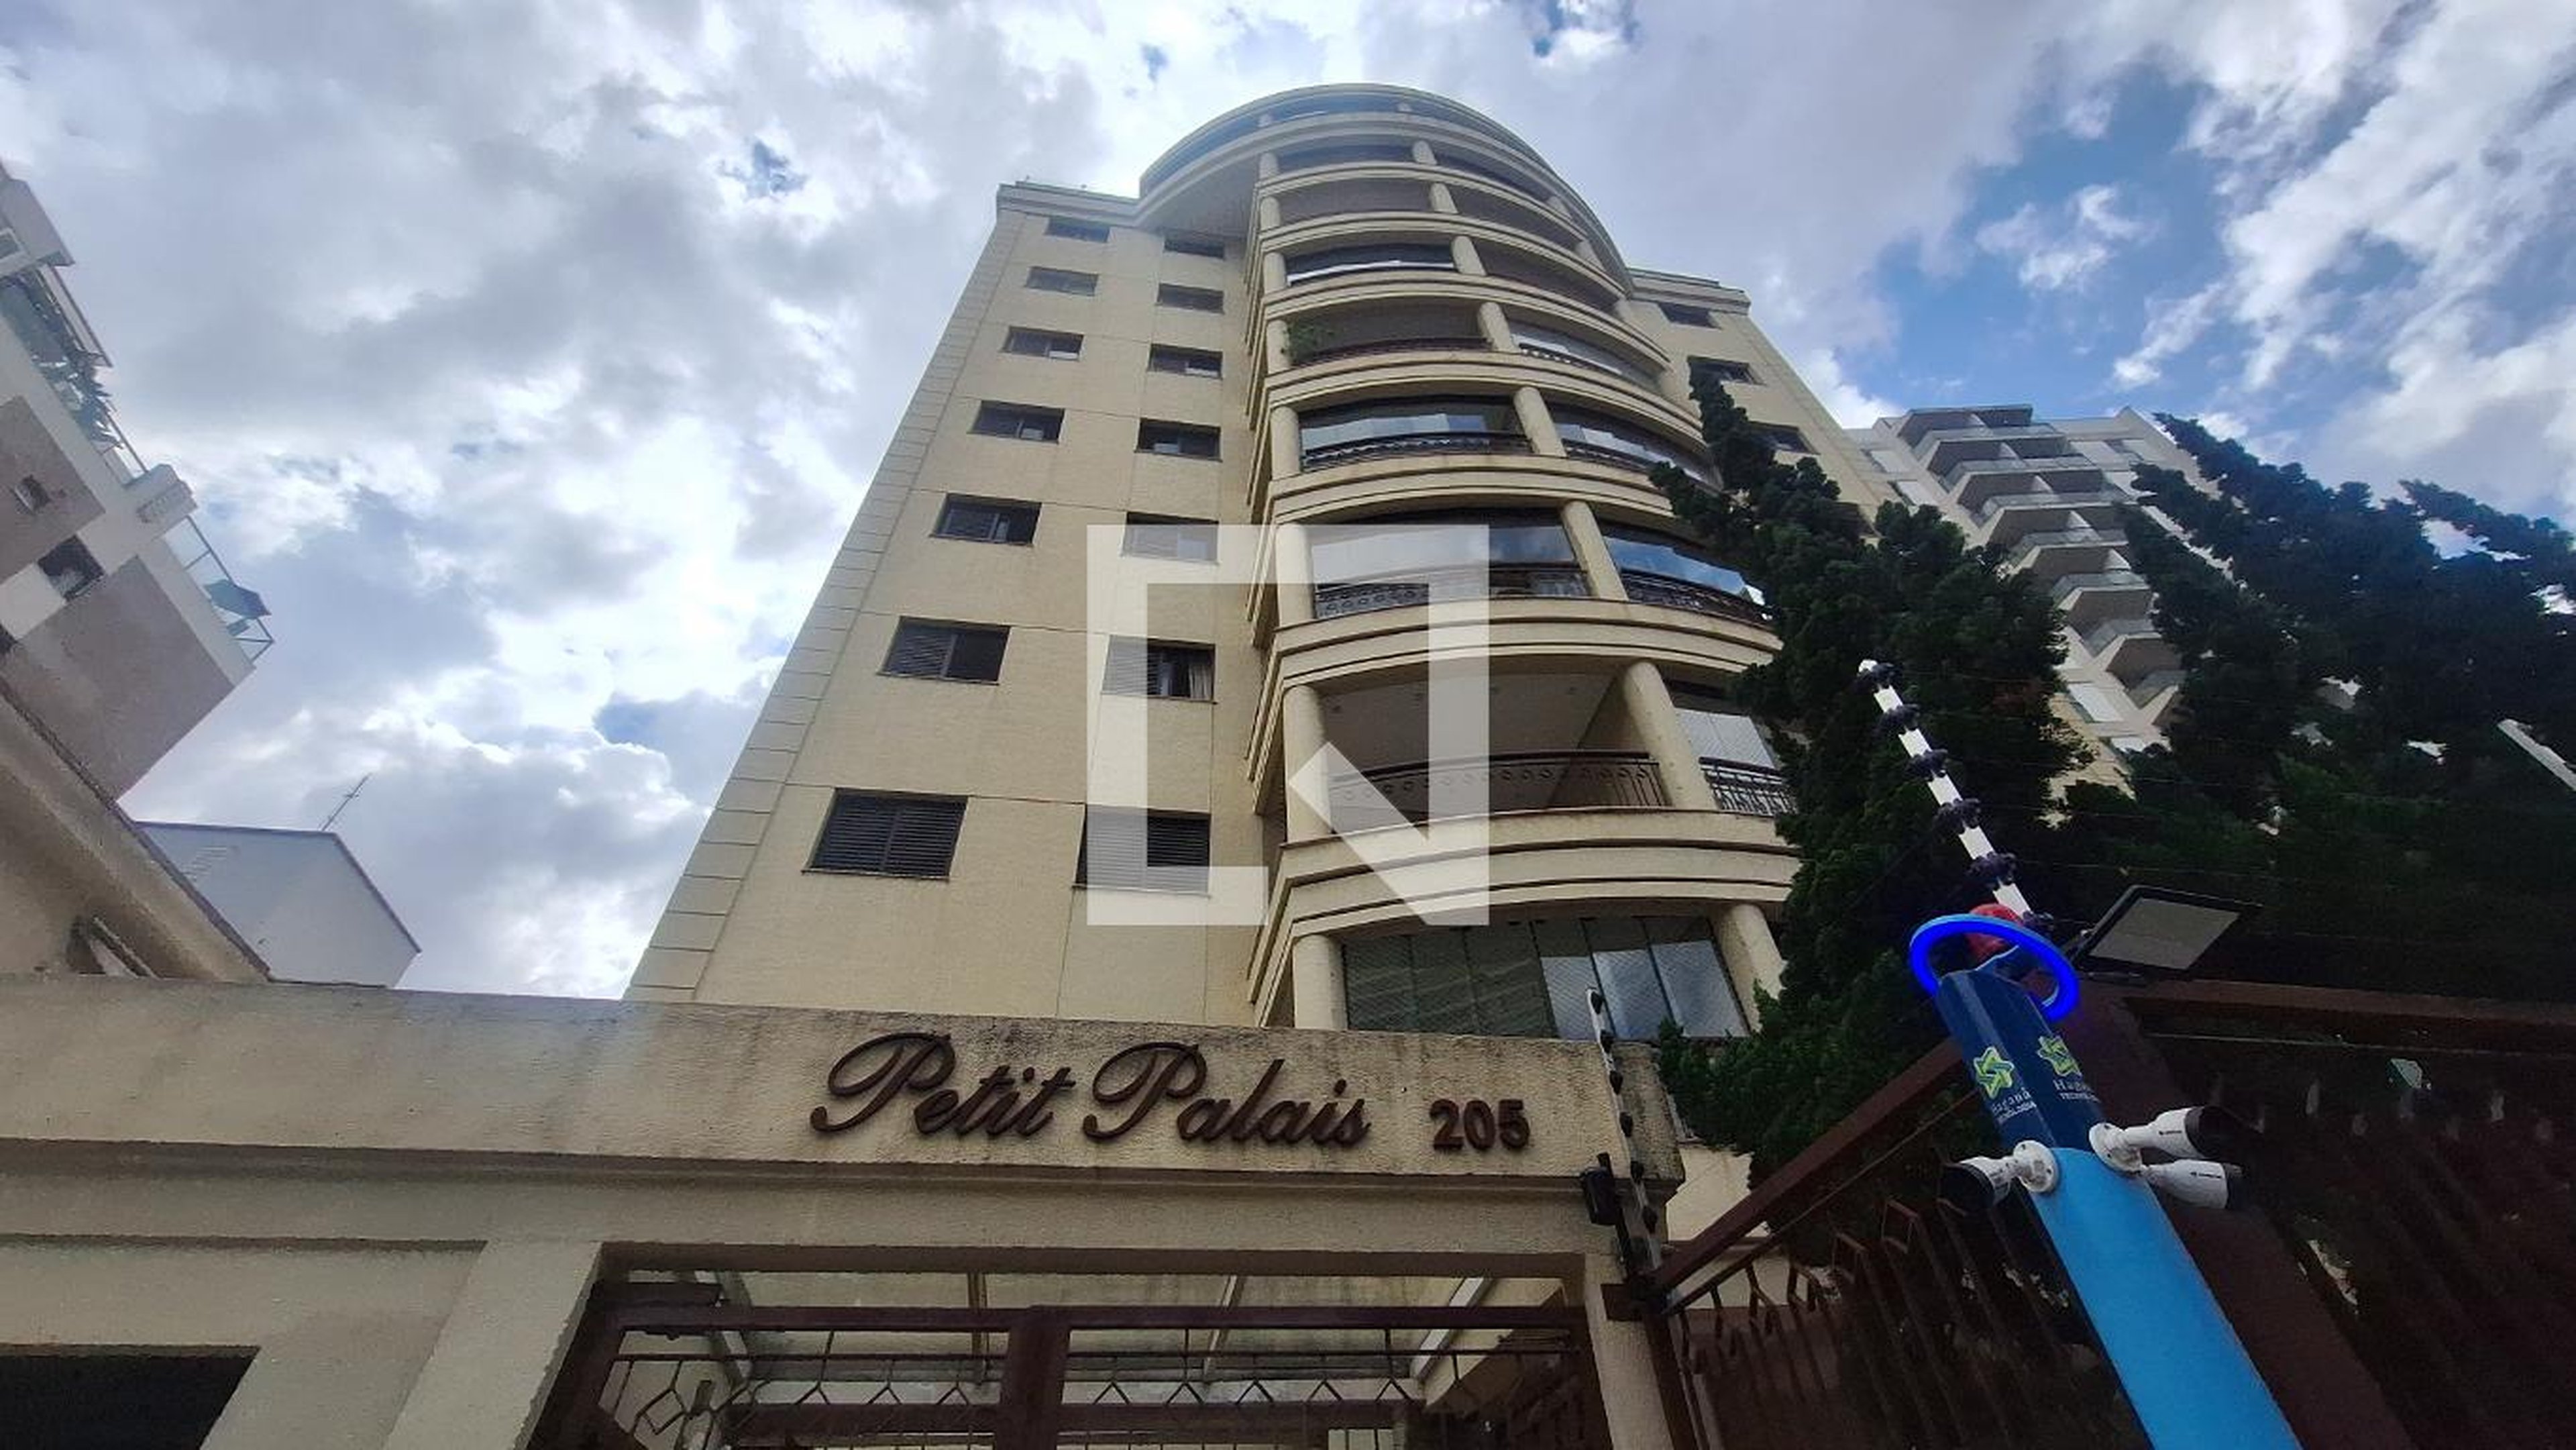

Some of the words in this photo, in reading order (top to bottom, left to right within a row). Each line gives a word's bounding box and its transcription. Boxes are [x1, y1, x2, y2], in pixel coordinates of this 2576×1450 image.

[810, 1033, 1075, 1136] Petit
[1082, 1042, 1371, 1143] Palais
[1430, 1099, 1531, 1152] 205
